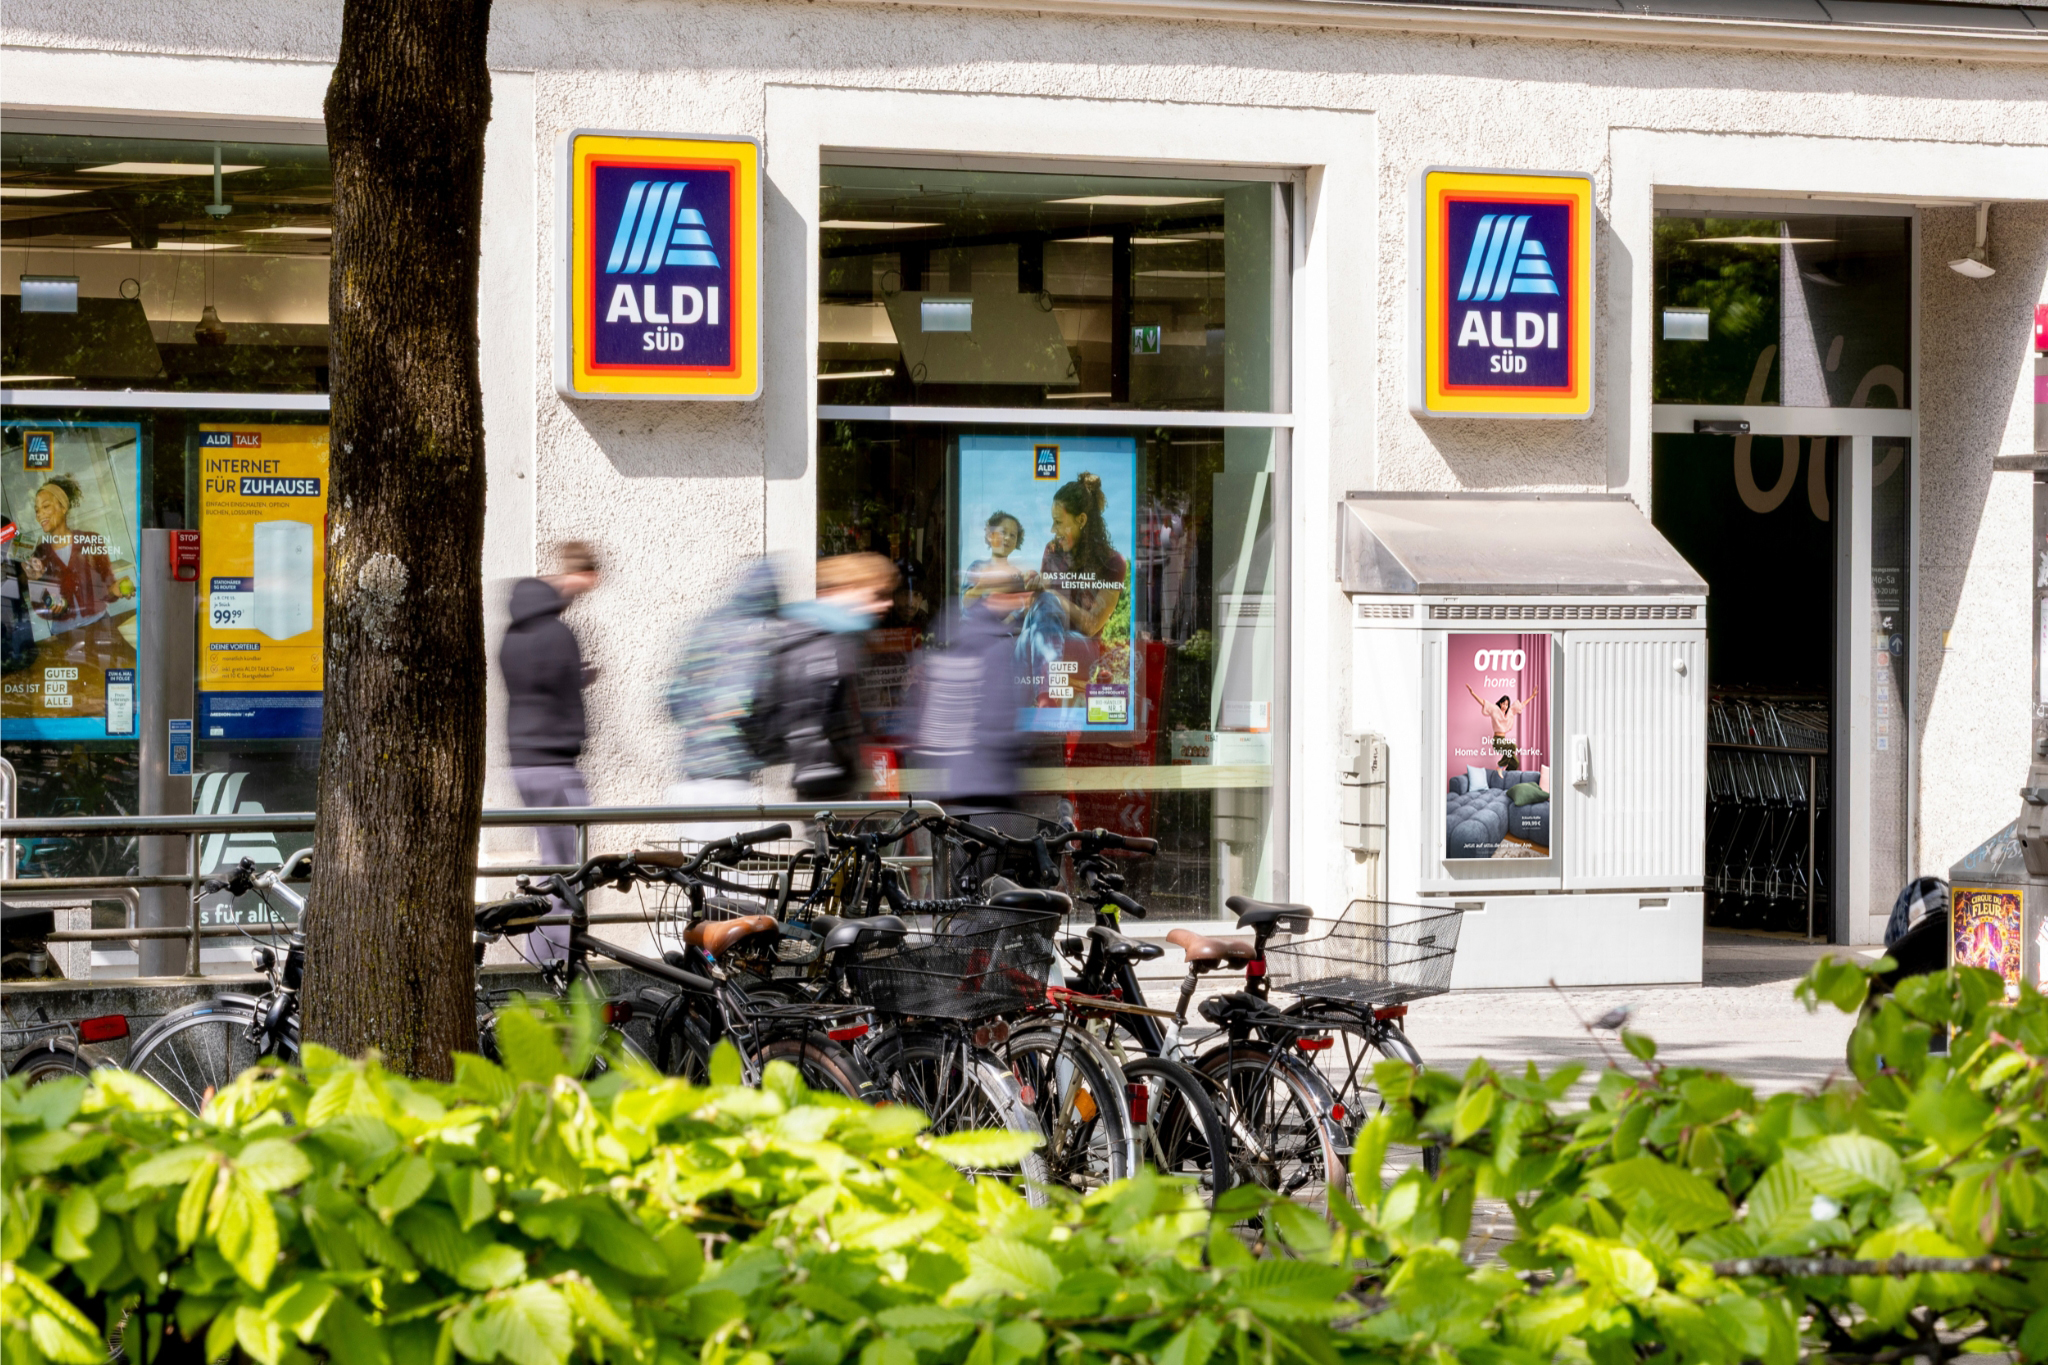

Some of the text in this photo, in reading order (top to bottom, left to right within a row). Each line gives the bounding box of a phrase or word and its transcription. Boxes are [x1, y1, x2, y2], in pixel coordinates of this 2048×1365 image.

[606, 284, 719, 325] ALDI
[1457, 310, 1559, 349] ALDI
[643, 326, 684, 351] SÜD
[1490, 349, 1527, 373] SÜD
[206, 434, 259, 445] ALDI TALK
[28, 453, 49, 462] ALDI
[205, 459, 280, 474] INTERNET
[1037, 464, 1056, 472] ALDI
[205, 475, 319, 495] FÜR ZUHAUSE.
[41, 534, 111, 544] NICHT SPAREN
[81, 543, 124, 555] MÜSSEN.
[1043, 572, 1096, 580] DAS SICH ALLE
[1061, 579, 1127, 590] LEISTEN KÖNNEN.
[1474, 649, 1526, 671] OTTO
[1050, 664, 1077, 672] GUTES
[46, 669, 77, 679] GUTES
[1050, 674, 1067, 684] FÜR
[1032, 676, 1045, 685] IST
[1484, 675, 1516, 688] home
[4, 684, 40, 693] DAS IST
[46, 682, 66, 693] FÜR
[1050, 688, 1072, 697] ALLE.
[45, 697, 71, 706] ALLE.
[1481, 736, 1495, 745] Die
[1454, 747, 1543, 758] Home & Living-Marke.
[1971, 894, 2002, 905] CIRQUE DU
[215, 903, 243, 924] für
[247, 902, 285, 923] alle.
[1972, 903, 2002, 919] FLEUR
